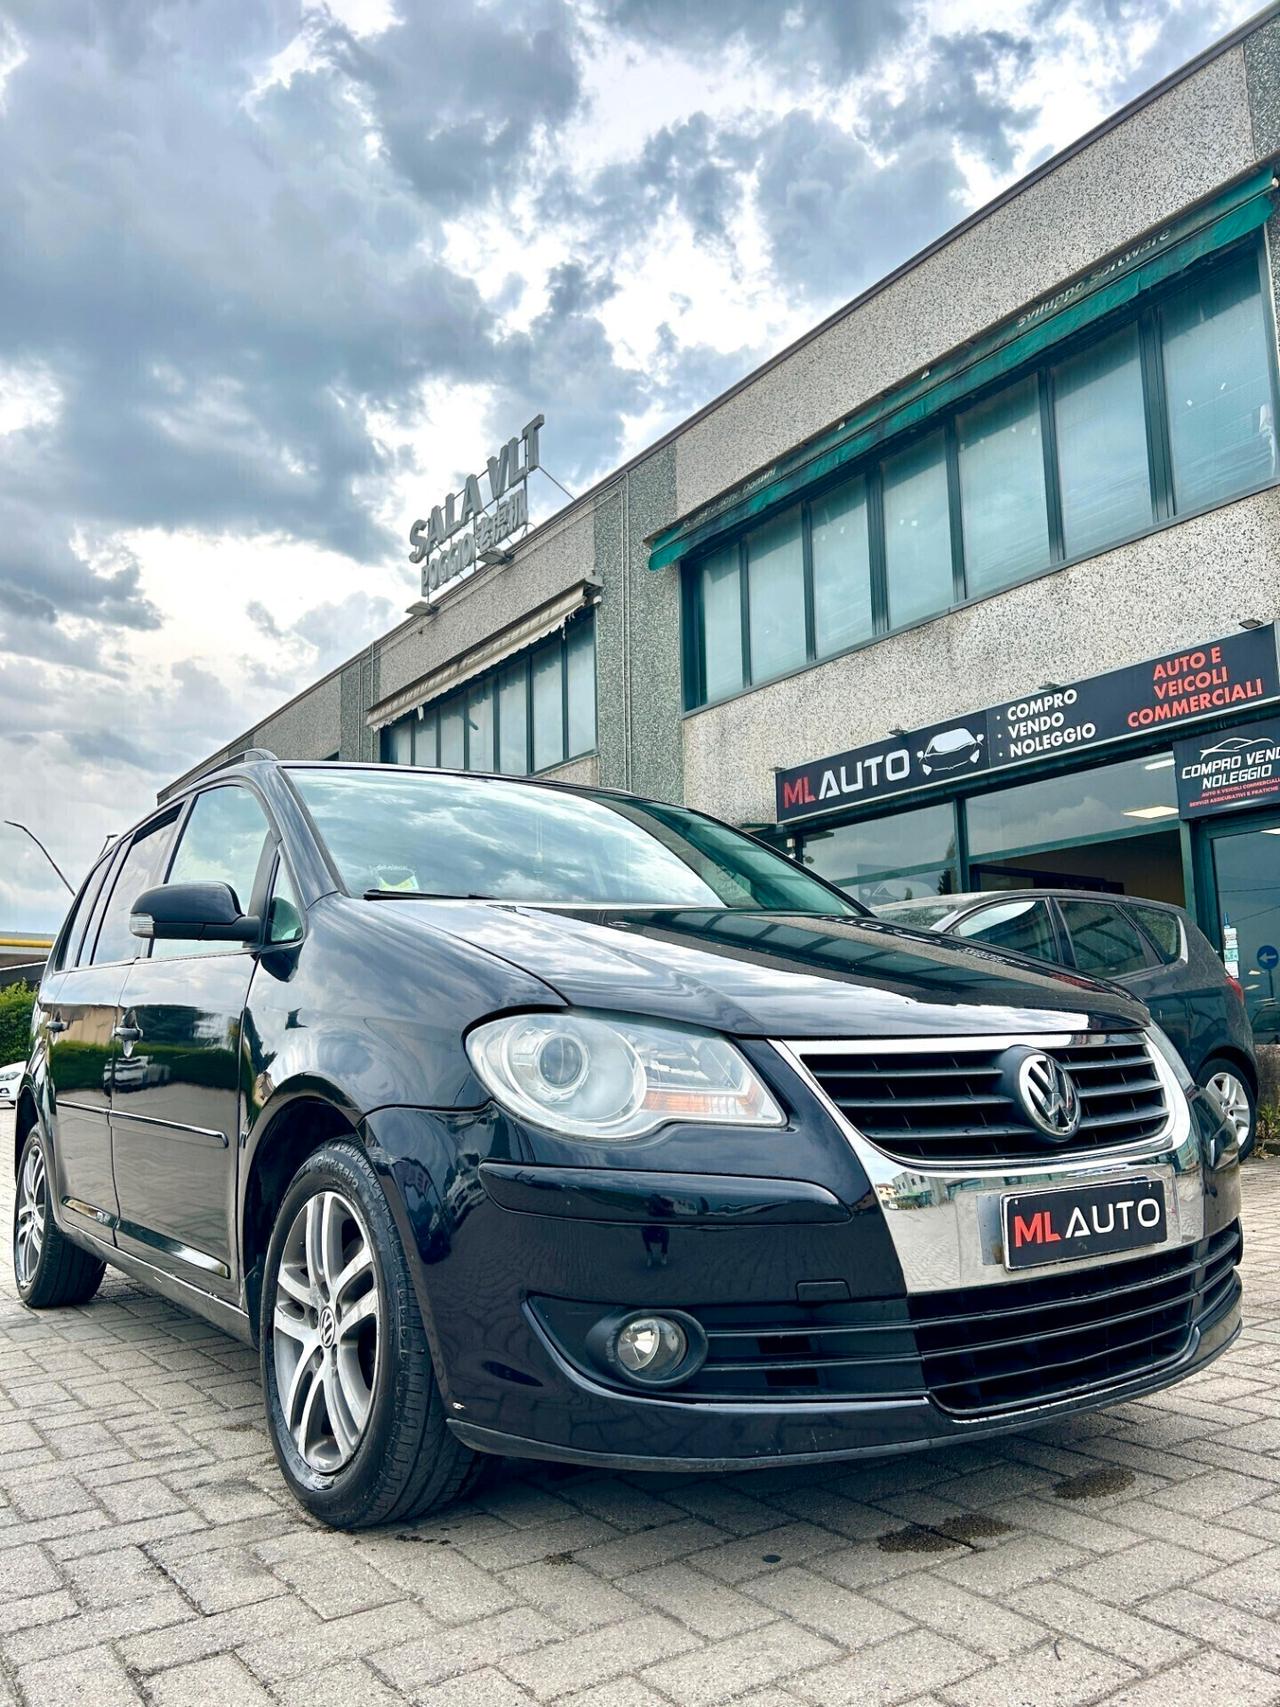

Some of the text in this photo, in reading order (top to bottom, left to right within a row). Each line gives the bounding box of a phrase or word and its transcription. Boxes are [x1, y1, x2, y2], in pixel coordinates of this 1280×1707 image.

[409, 414, 545, 564] SALA VLT
[1153, 646, 1221, 681] AUTO E
[1153, 666, 1228, 700] VEICOLI
[1007, 688, 1078, 721] COMPRO
[1127, 678, 1263, 728] COMMERCIALI
[1008, 711, 1065, 739] VENDO
[1009, 722, 1096, 758] NOLEGGIO
[1181, 755, 1242, 780] COMPRO
[1202, 764, 1273, 790] NOLEGGIO
